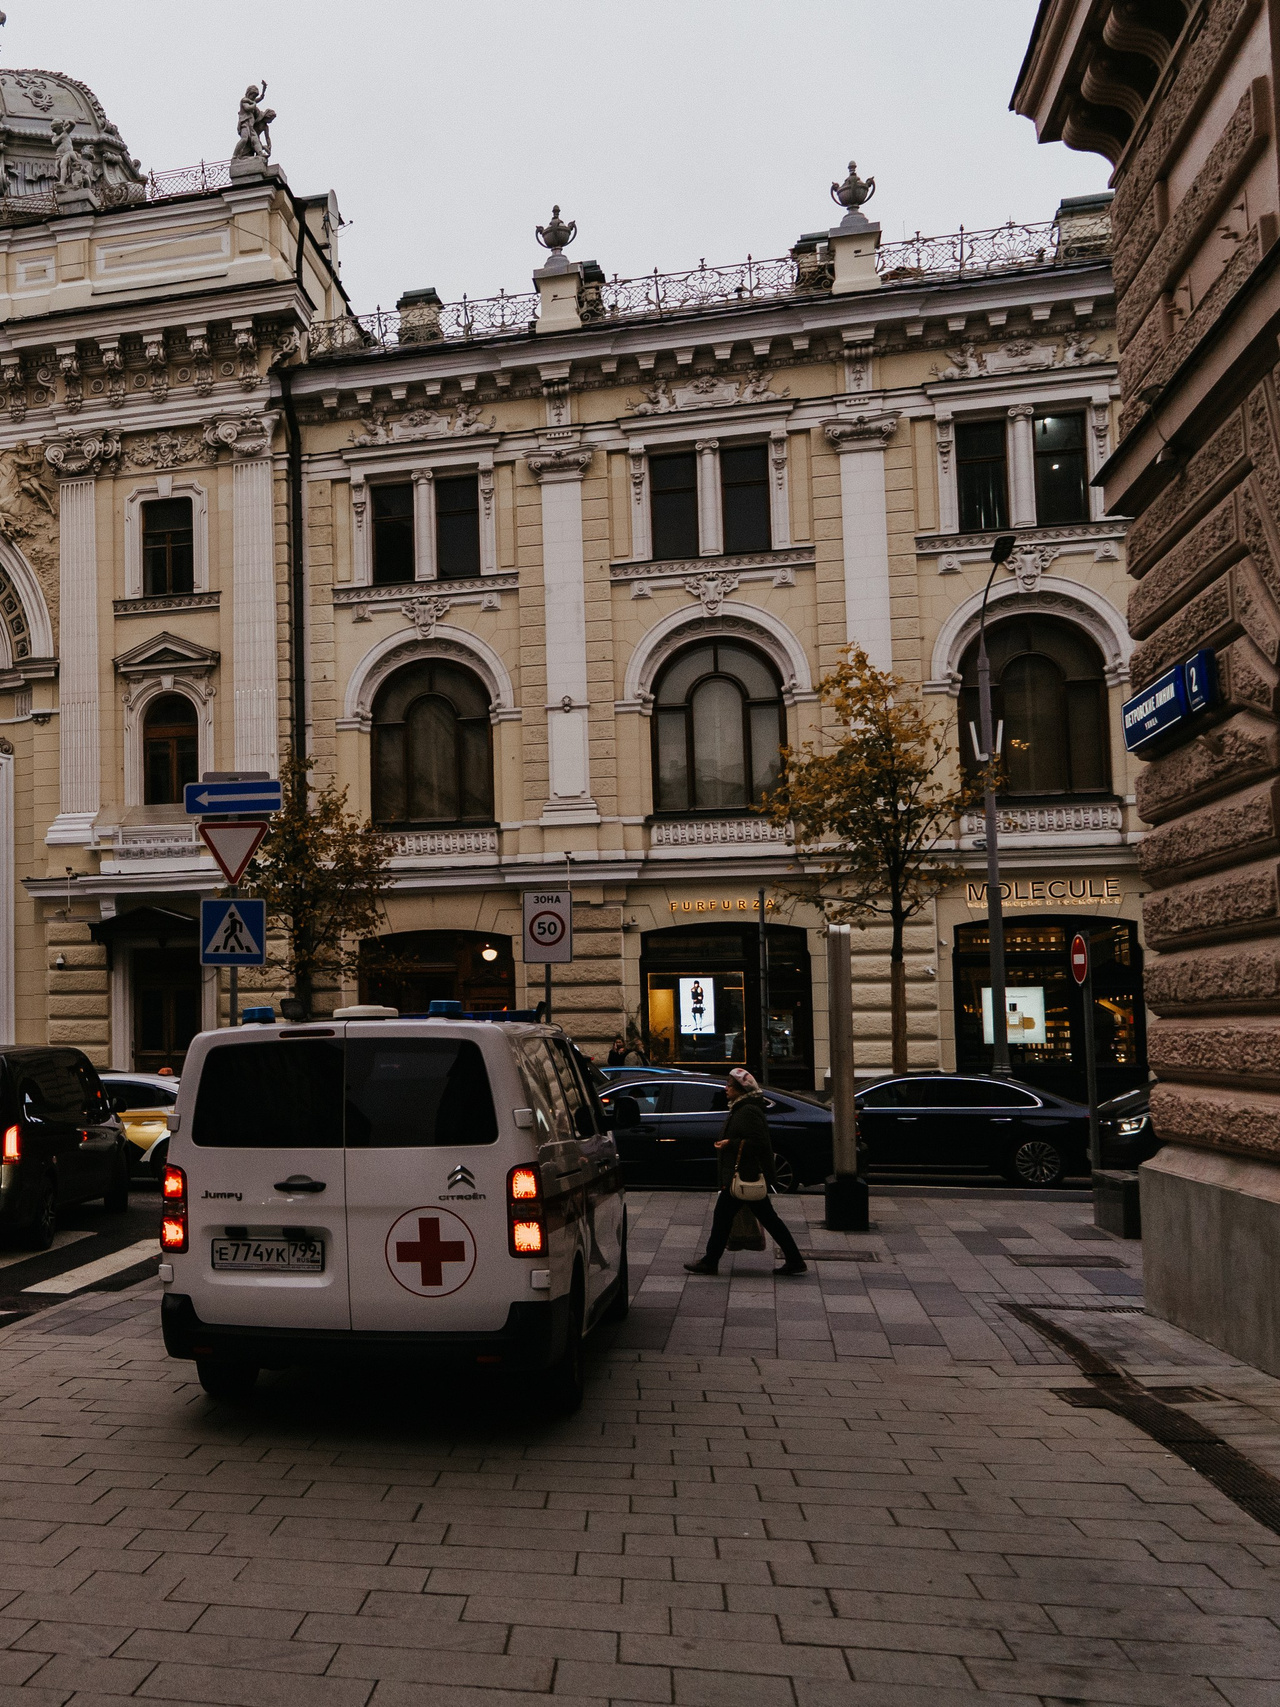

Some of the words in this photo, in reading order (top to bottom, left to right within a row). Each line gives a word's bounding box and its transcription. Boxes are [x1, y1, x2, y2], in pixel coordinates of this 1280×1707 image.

[1190, 667, 1199, 693] 2
[968, 878, 1121, 901] MOLECULE
[533, 895, 561, 904] ЗОНА
[670, 899, 775, 911] FURFURZA
[537, 921, 557, 936] 50
[219, 1243, 287, 1262] Е774УК
[290, 1242, 318, 1258] 799
